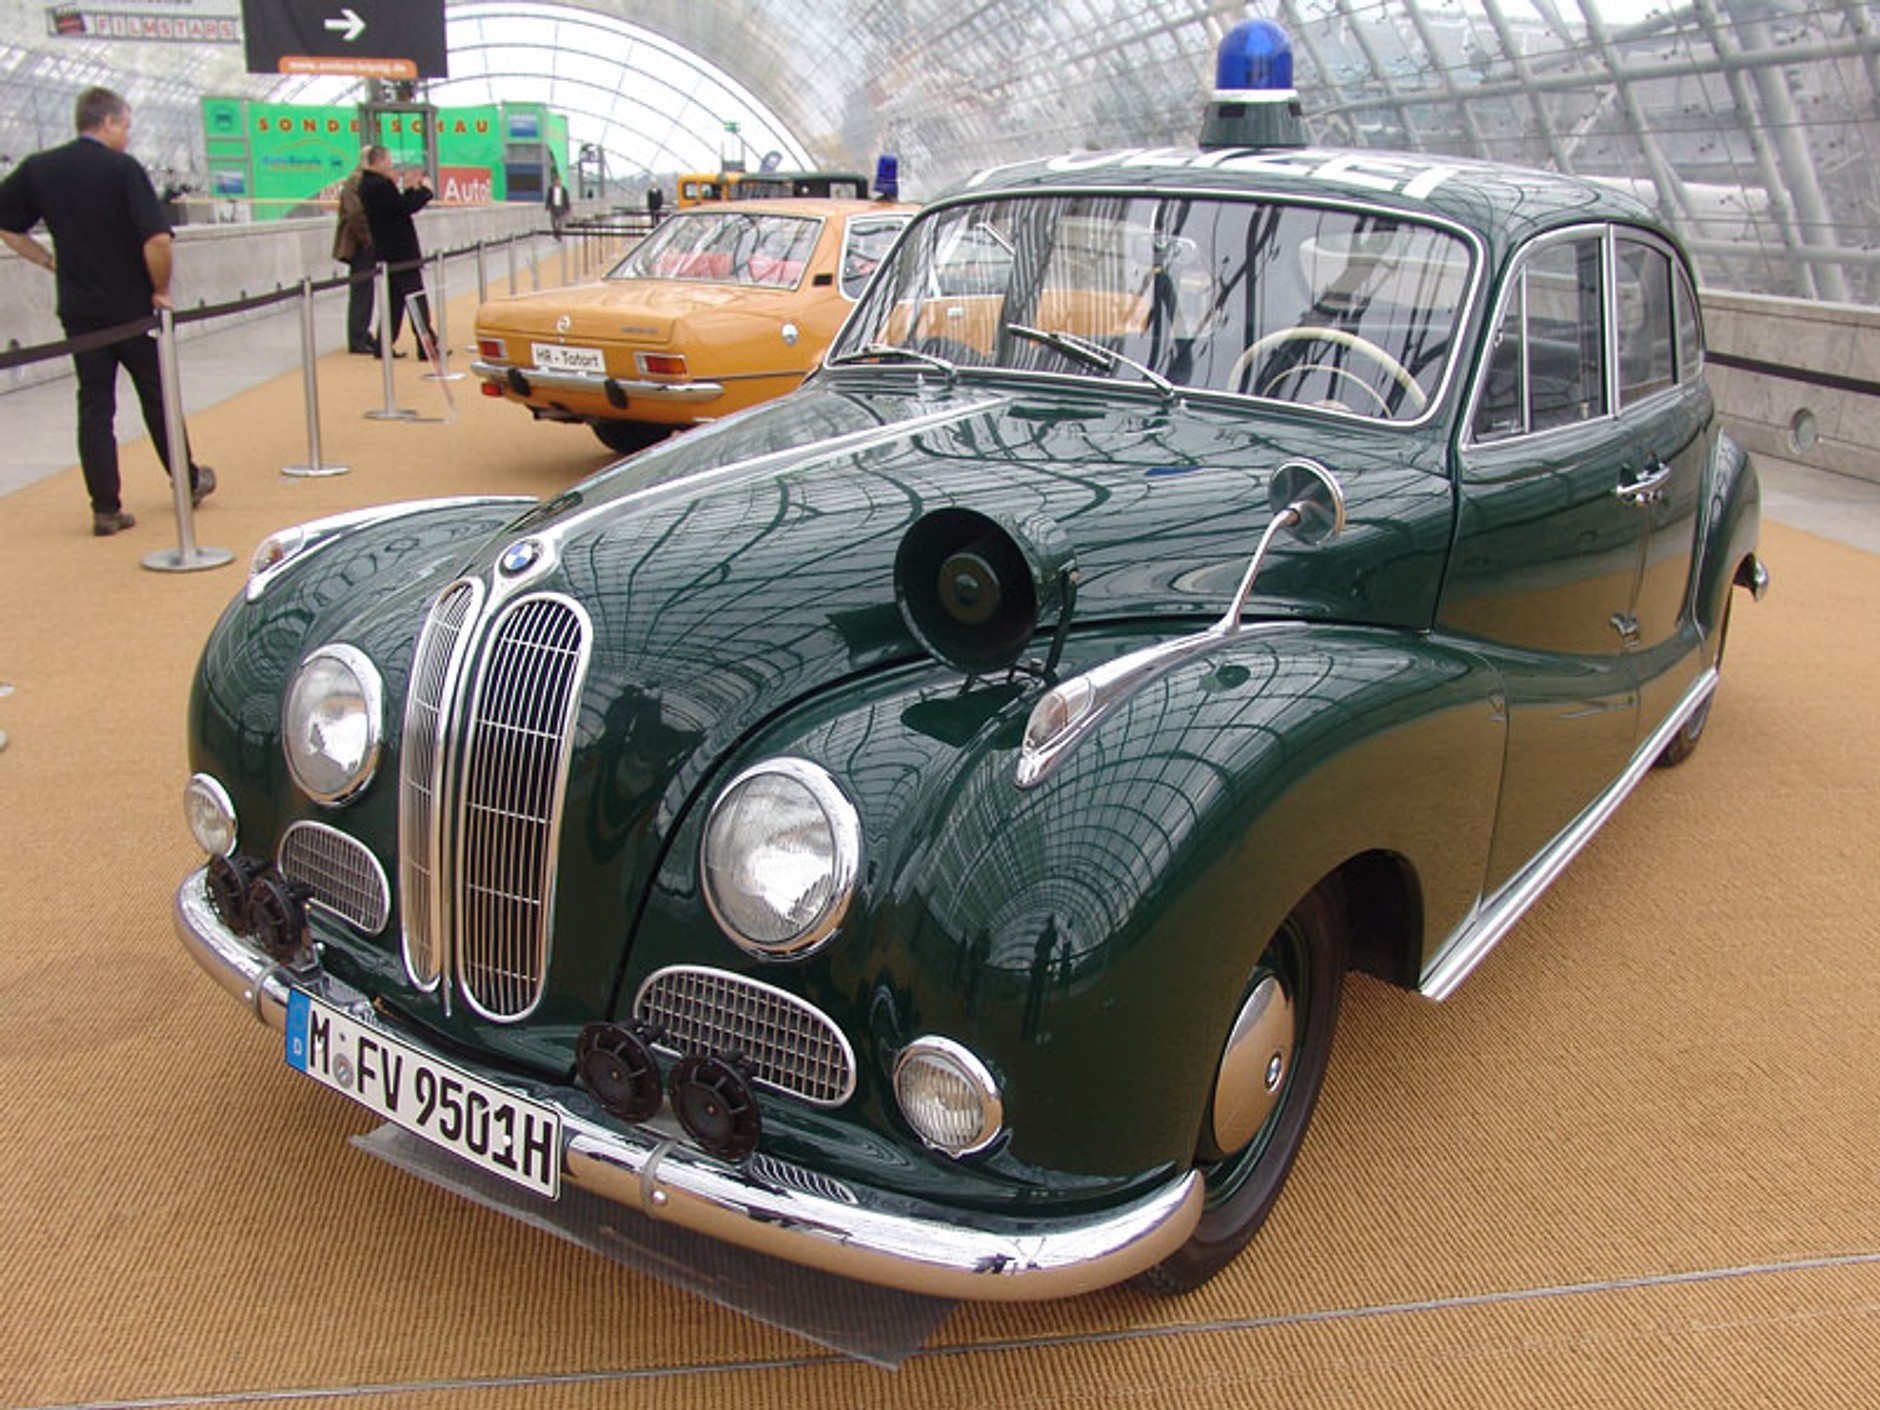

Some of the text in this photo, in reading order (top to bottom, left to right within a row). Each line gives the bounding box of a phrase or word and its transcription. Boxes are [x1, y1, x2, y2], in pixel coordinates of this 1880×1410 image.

[98, 15, 234, 36] FILMSTARS
[562, 351, 599, 367] Tatort
[310, 1010, 554, 1185] M FV 9501H
